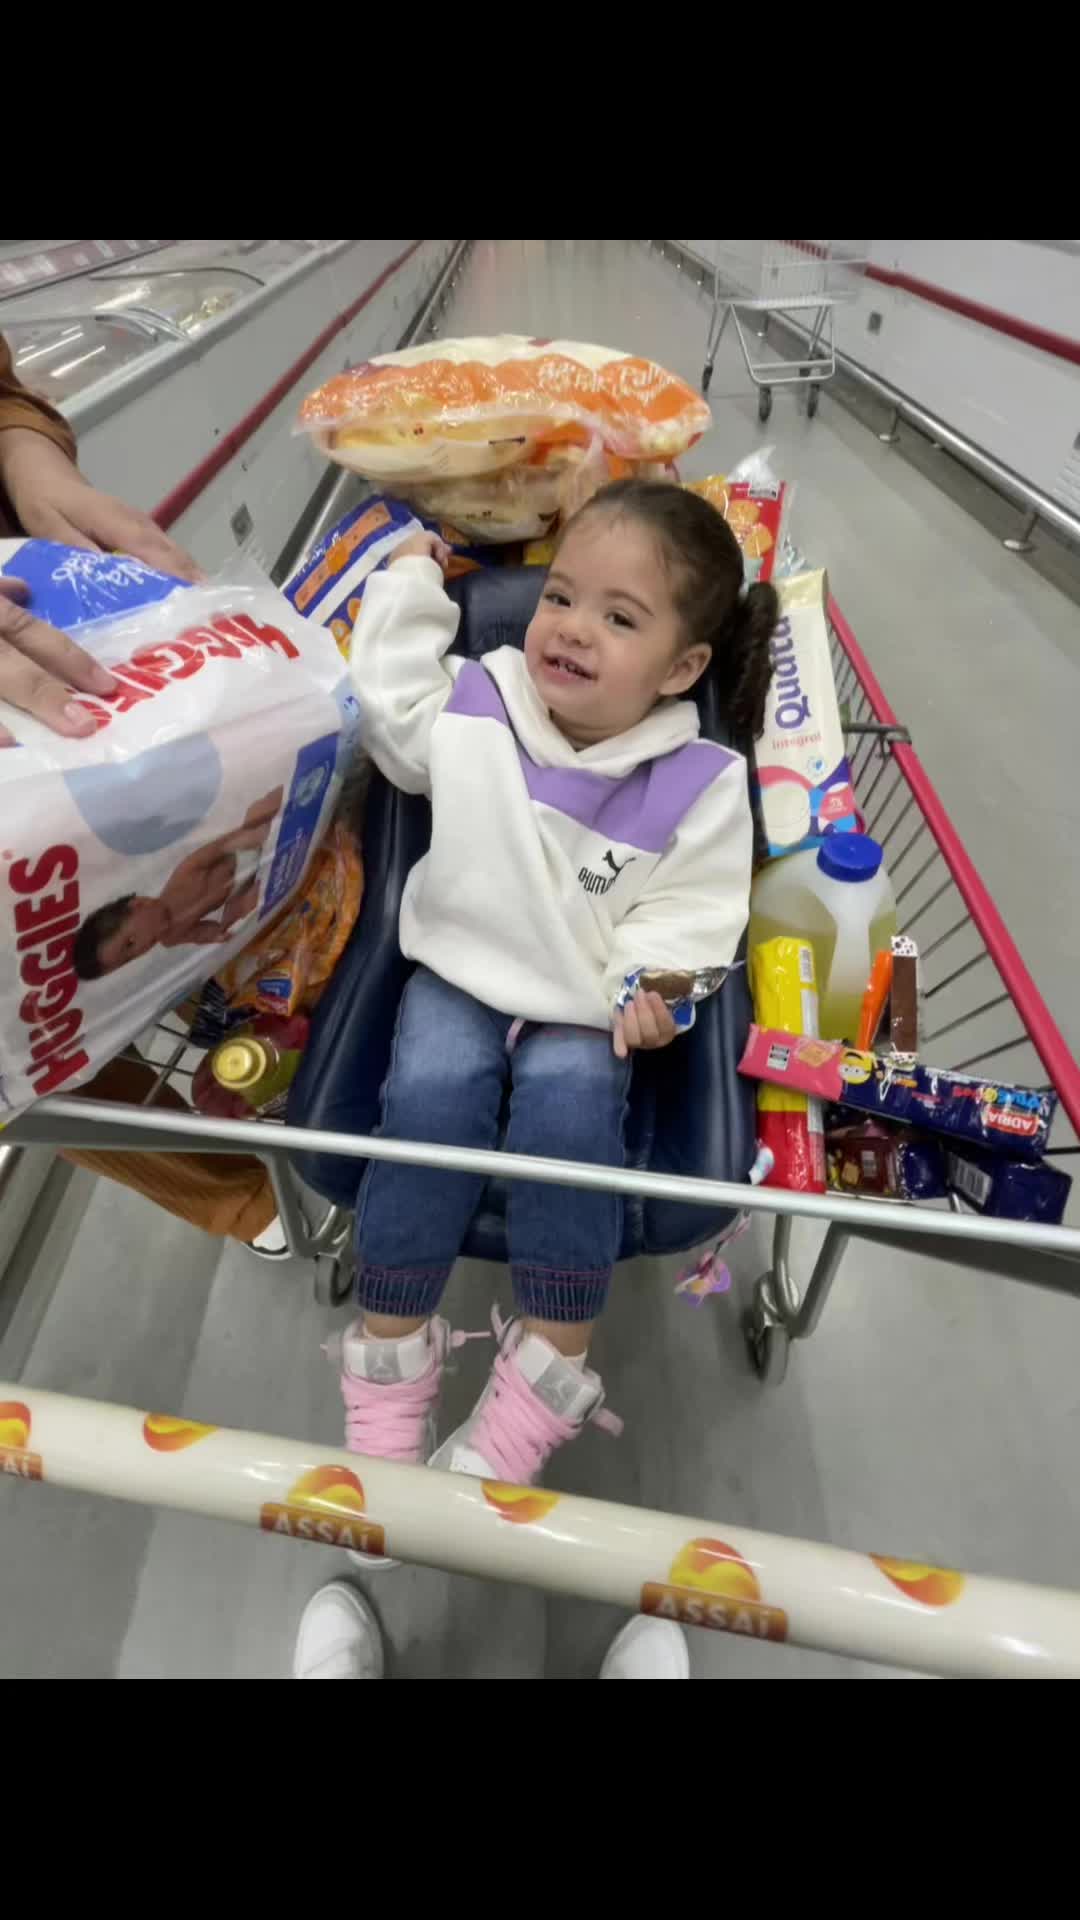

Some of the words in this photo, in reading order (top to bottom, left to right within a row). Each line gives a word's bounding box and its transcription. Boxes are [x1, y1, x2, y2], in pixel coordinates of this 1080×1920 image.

[577, 866, 616, 895] PUMA
[8, 844, 89, 1097] HUGGIES
[987, 1111, 1034, 1131] ADRIA
